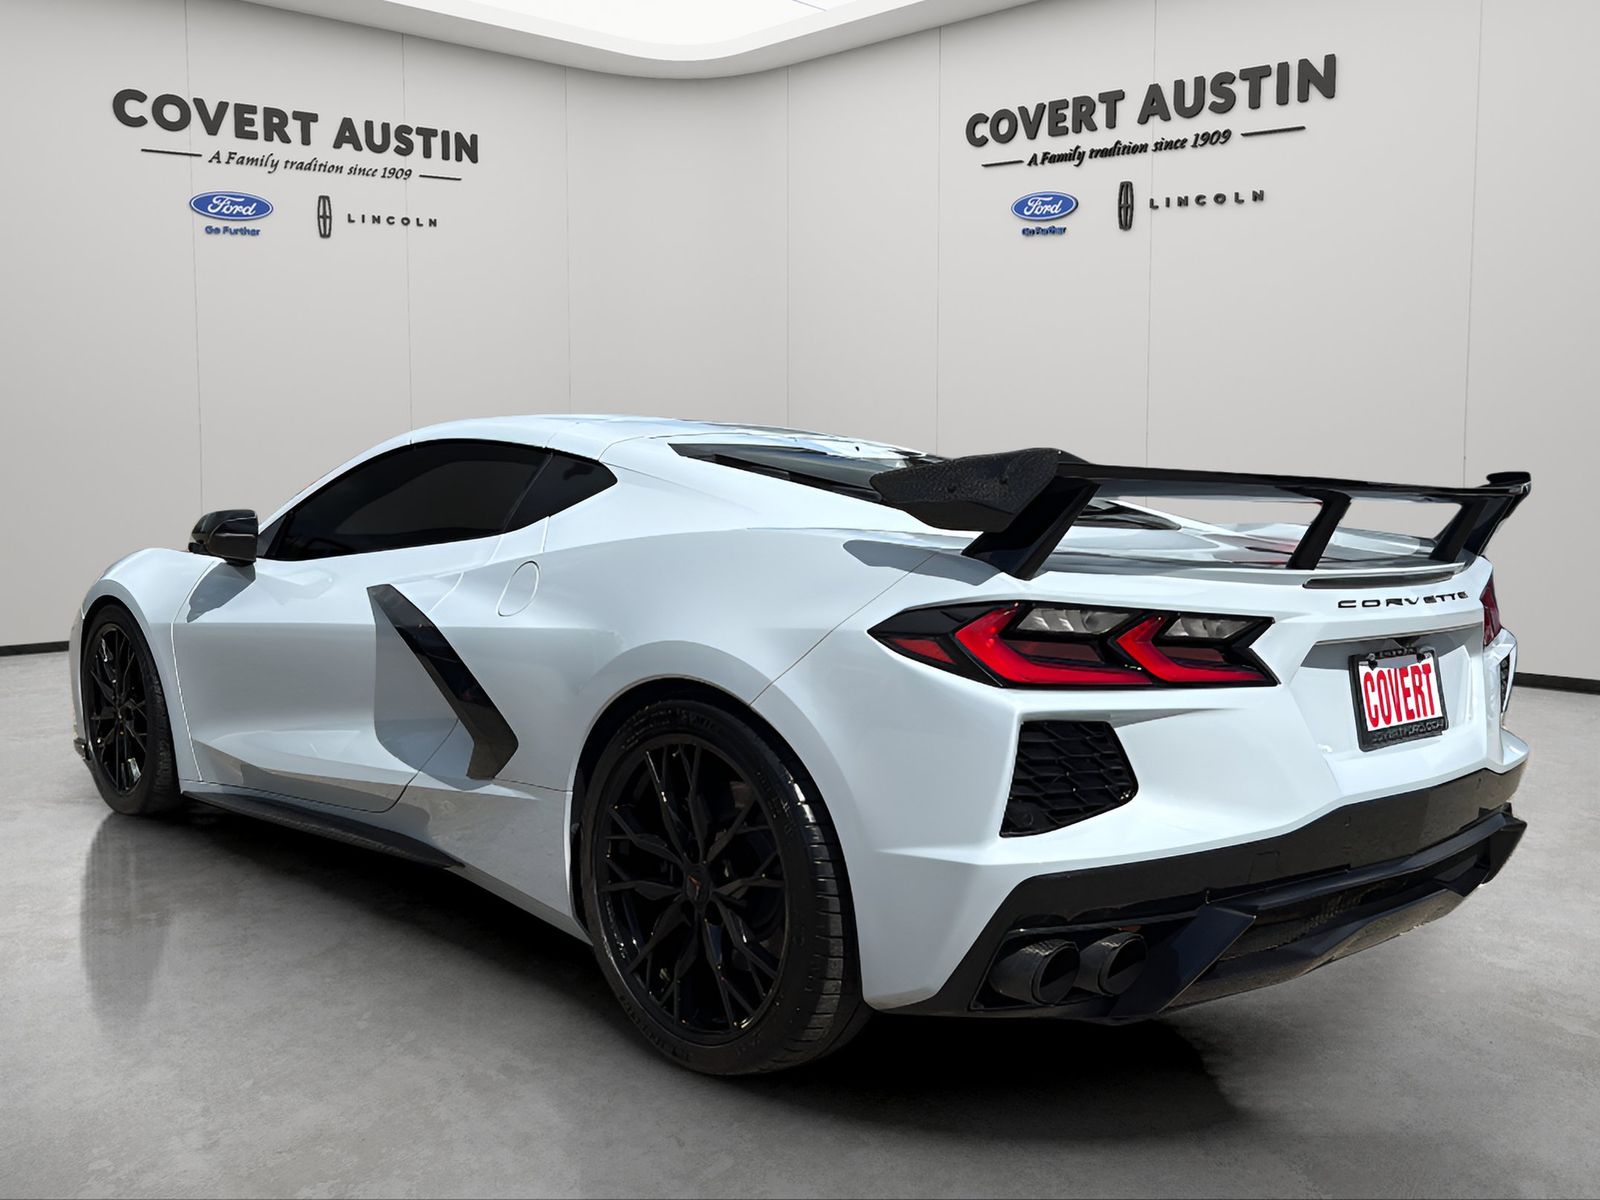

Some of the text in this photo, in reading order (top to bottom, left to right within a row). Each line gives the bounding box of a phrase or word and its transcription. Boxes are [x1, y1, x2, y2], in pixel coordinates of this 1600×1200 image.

[964, 53, 1337, 147] COVERT AUSTIN
[112, 88, 479, 164] COVERT AUSTIN
[1027, 128, 1232, 167] A Family tradition since 1909
[208, 150, 413, 180] A Family tradition since 1909
[207, 195, 257, 216] Ford
[1023, 196, 1063, 215] Ford
[1149, 189, 1265, 209] LINCOLN
[347, 213, 438, 227] LINCOLN
[1337, 591, 1469, 609] CORVETTE
[1363, 662, 1435, 728] COVERT
